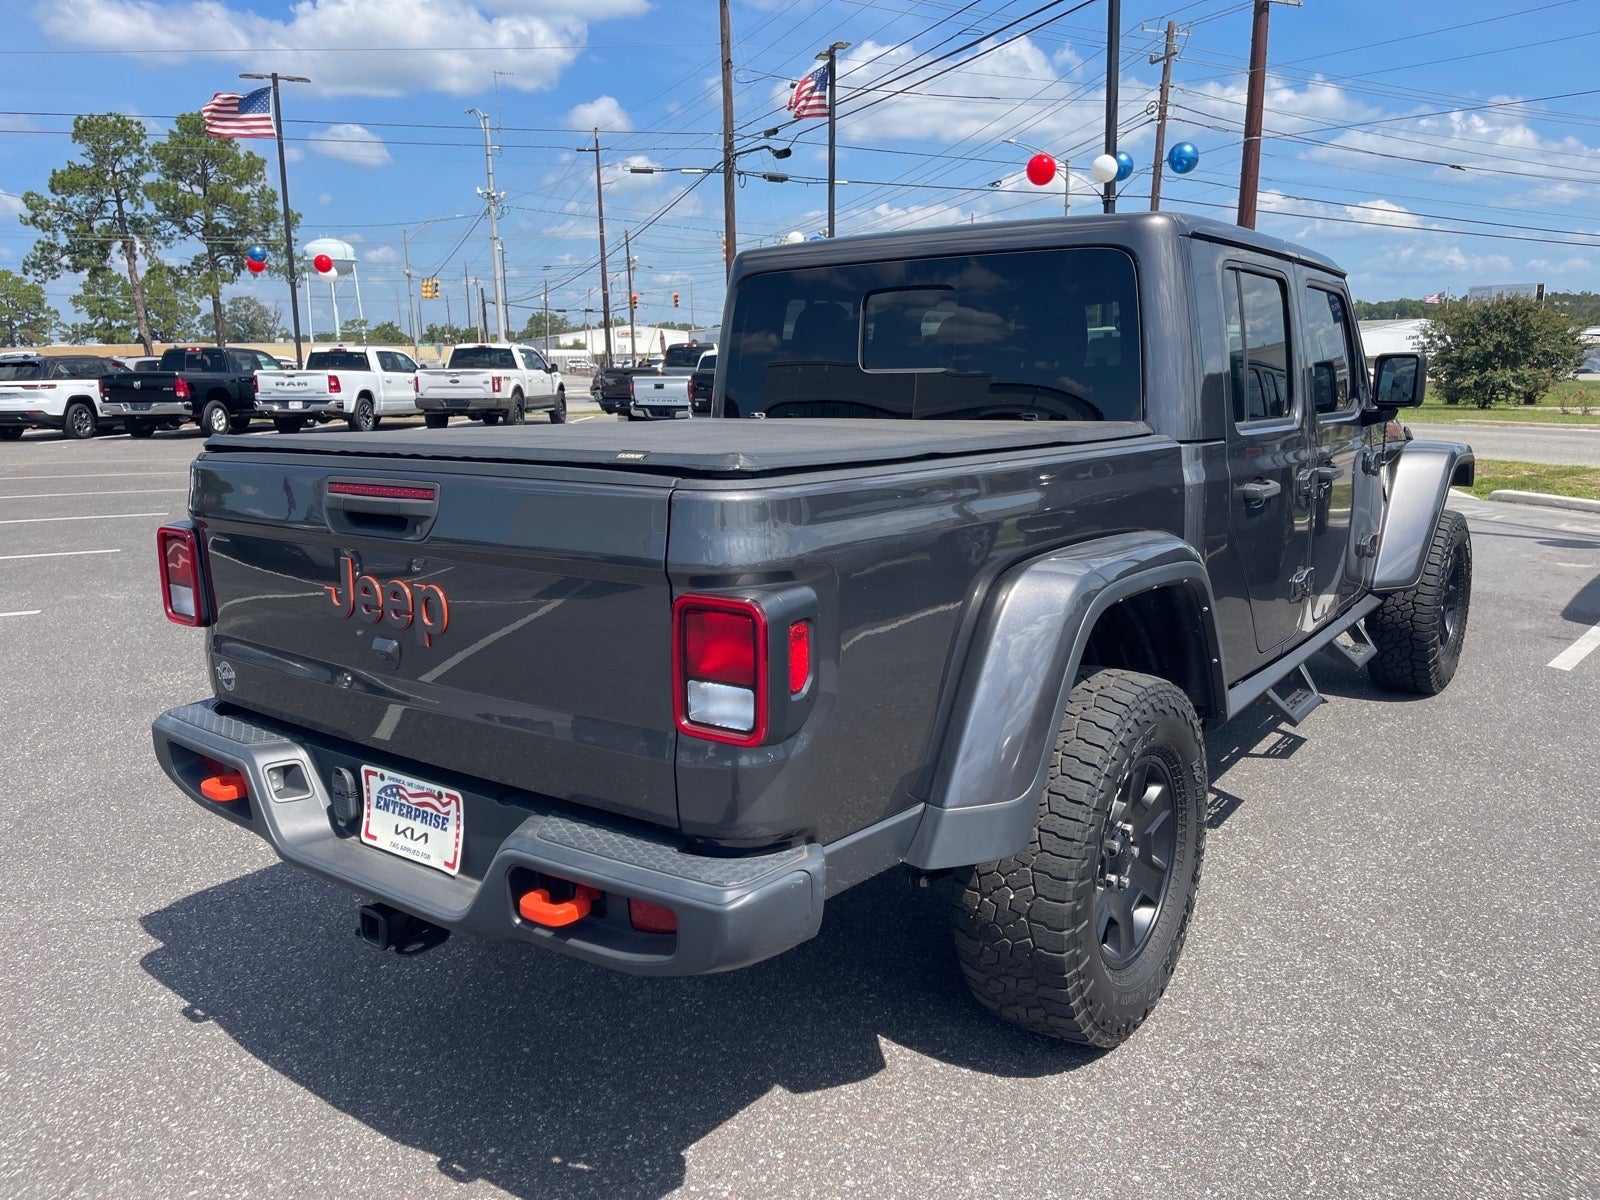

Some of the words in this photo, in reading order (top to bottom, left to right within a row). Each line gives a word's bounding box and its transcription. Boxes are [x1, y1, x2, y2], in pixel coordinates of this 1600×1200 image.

[324, 556, 449, 648] Jeep
[414, 784, 425, 792] LOVE
[375, 795, 449, 832] ENTERPRISE
[395, 823, 429, 844] KIA
[389, 841, 400, 850] TAG
[400, 844, 420, 856] APPLIED
[420, 851, 431, 860] FOR
